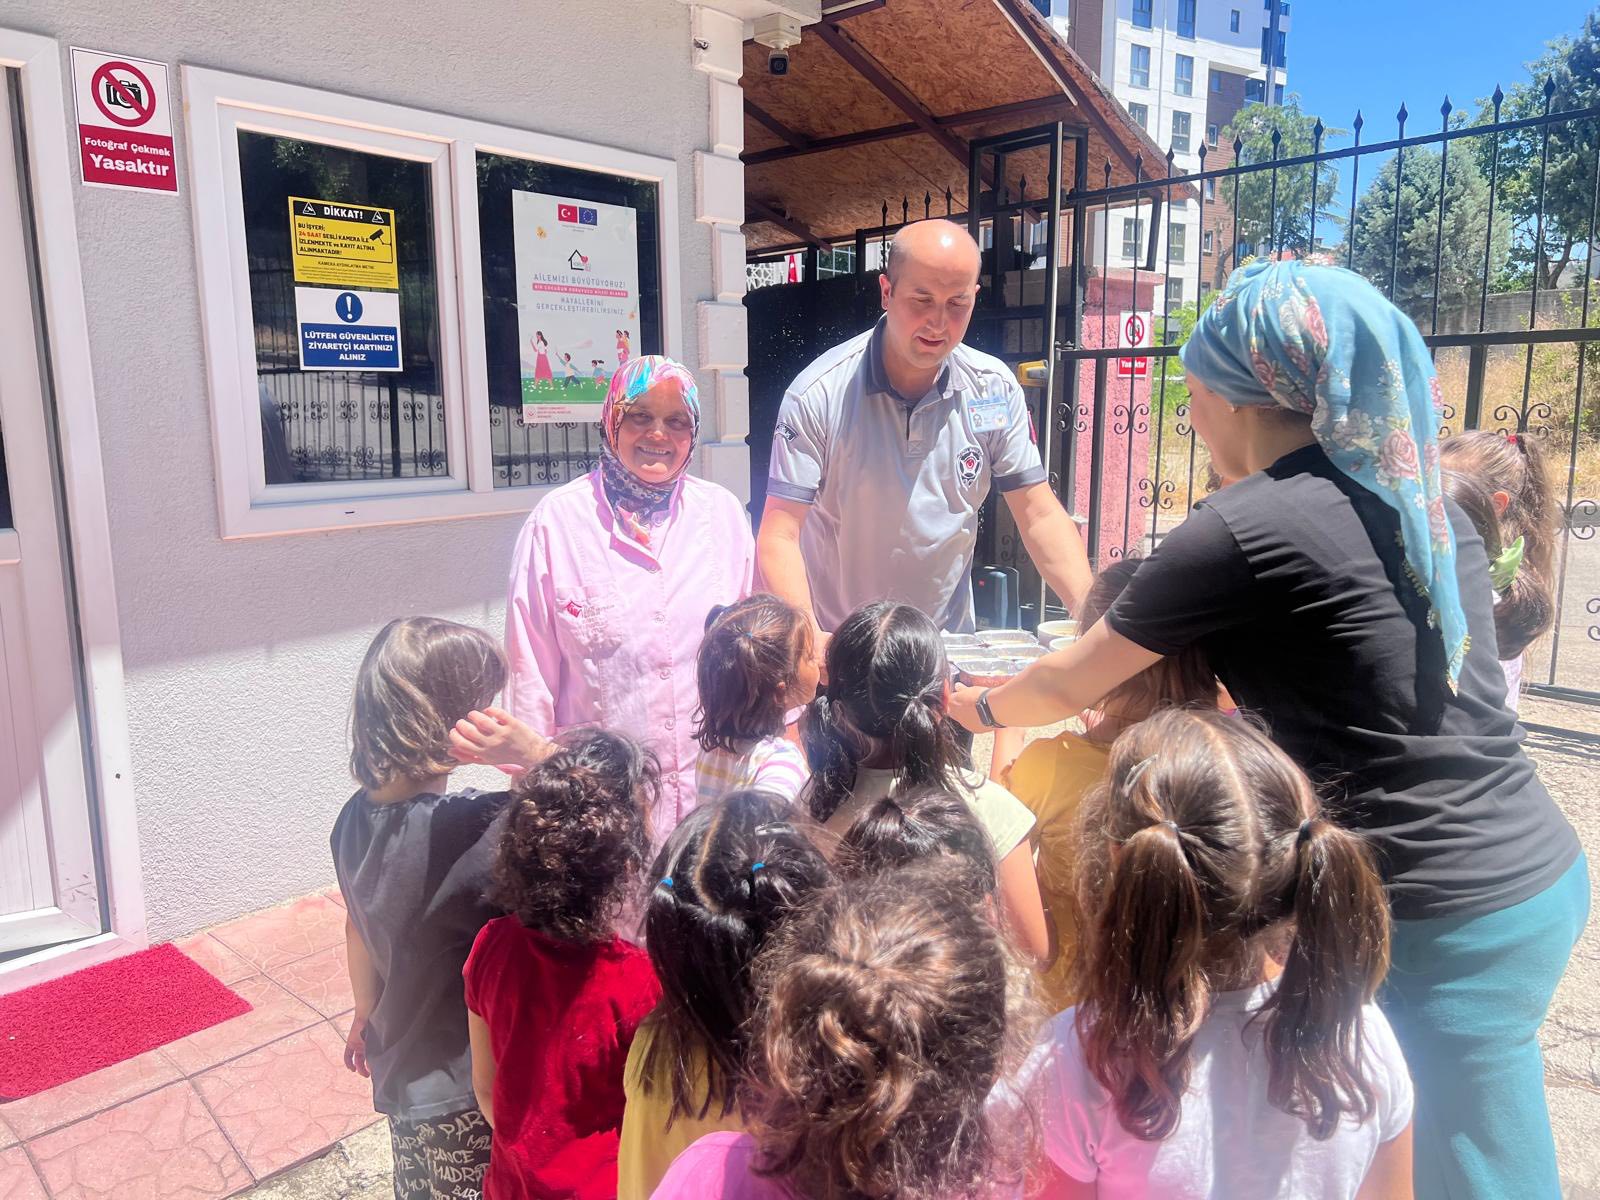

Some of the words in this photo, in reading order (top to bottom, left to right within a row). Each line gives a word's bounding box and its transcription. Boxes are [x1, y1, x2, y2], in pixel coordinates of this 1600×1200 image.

[85, 137, 128, 150] Fotoğraf
[131, 143, 170, 156] Çekmek
[90, 153, 169, 176] Yasaktır
[324, 206, 363, 219] DİKKAT!
[299, 239, 332, 247] İZLENMEKTE
[305, 331, 337, 339] LÜTFEN
[339, 332, 395, 342] GÜVENLİKTEN
[308, 342, 351, 351] ZİYARETÇİ
